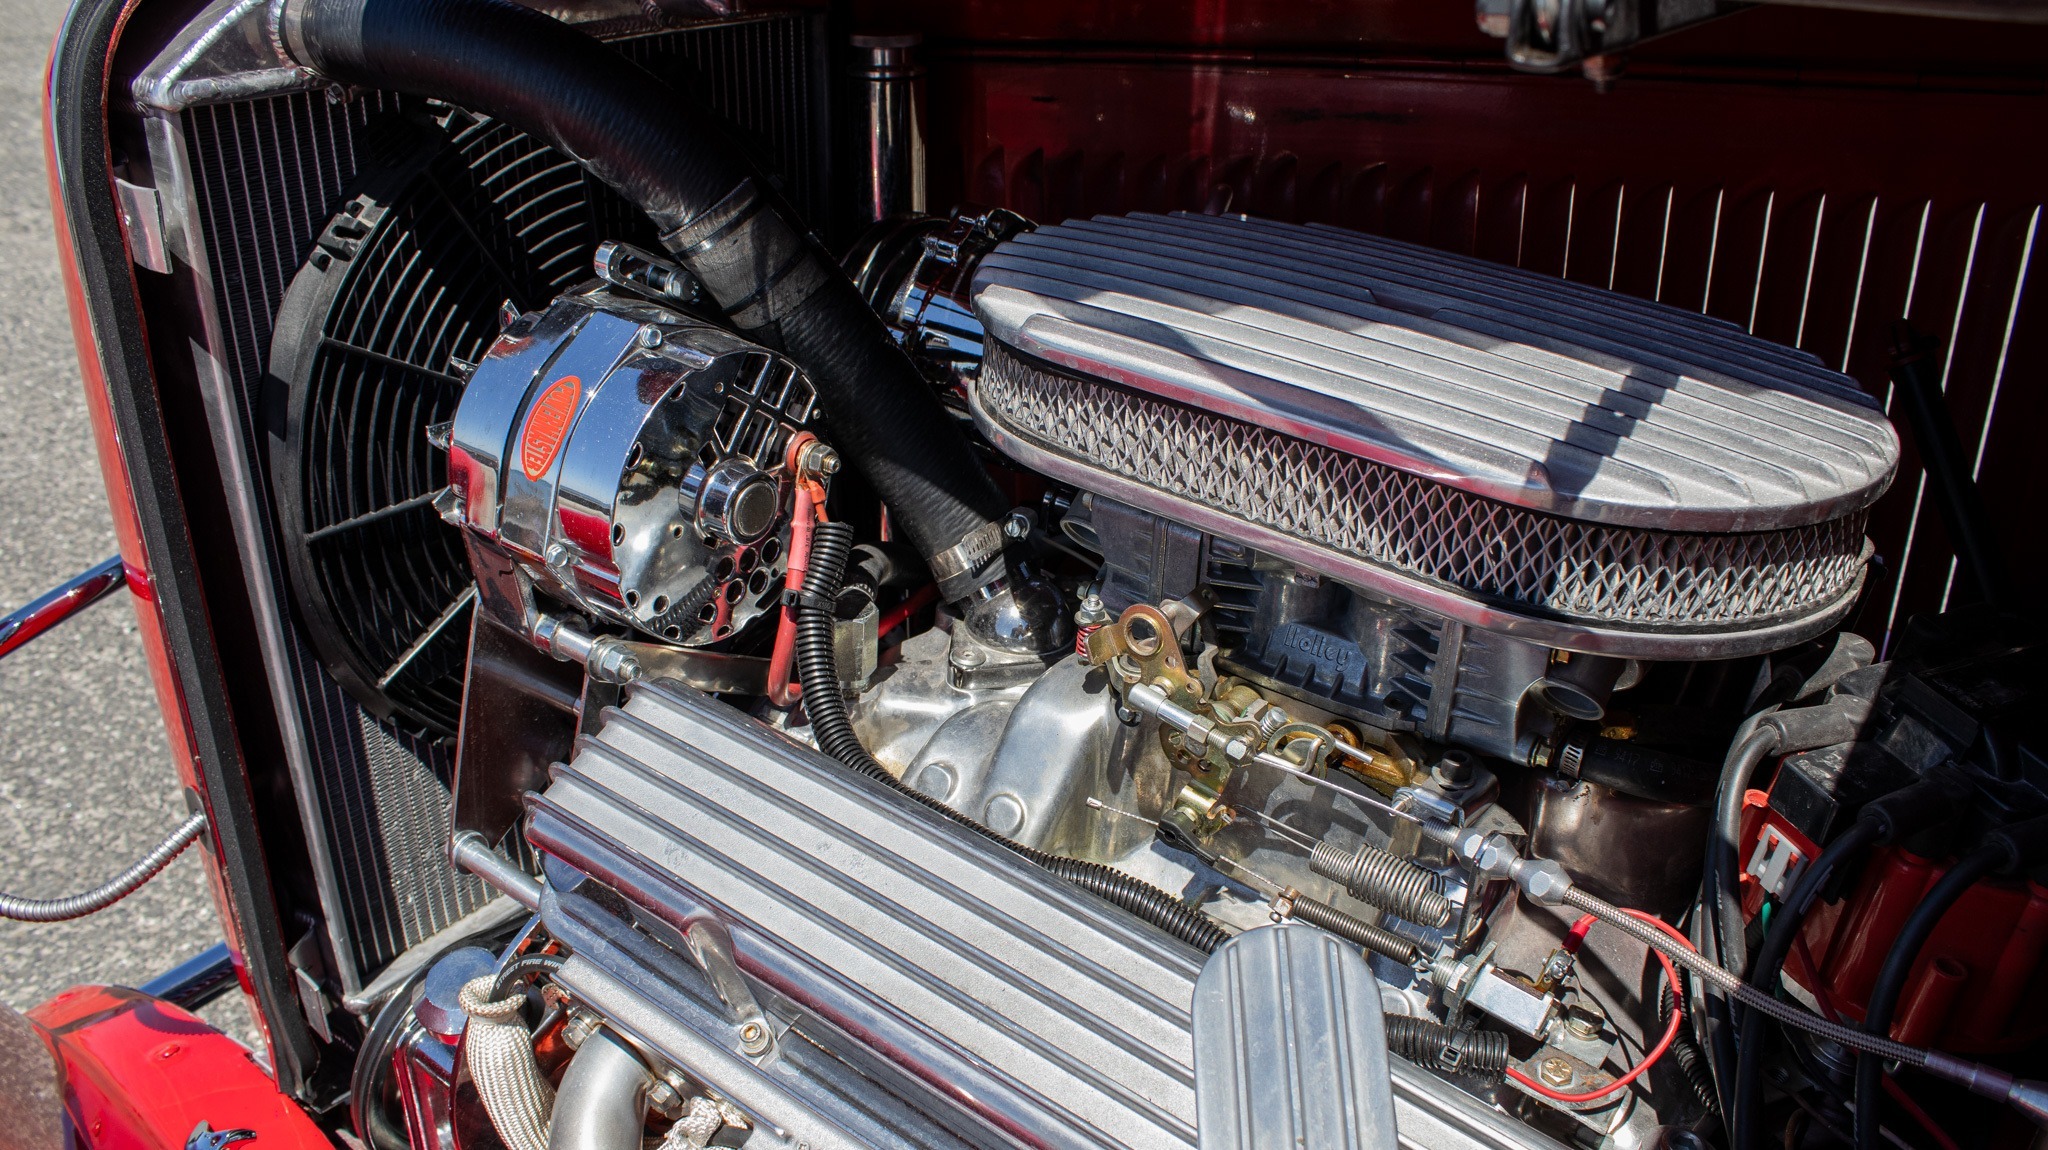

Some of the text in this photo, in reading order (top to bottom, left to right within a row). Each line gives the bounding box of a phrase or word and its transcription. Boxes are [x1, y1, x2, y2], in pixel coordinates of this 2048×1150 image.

[526, 383, 574, 472] POWERMASTER
[1284, 625, 1352, 673] Holley
[495, 958, 563, 990] STREET FIRE WIR
